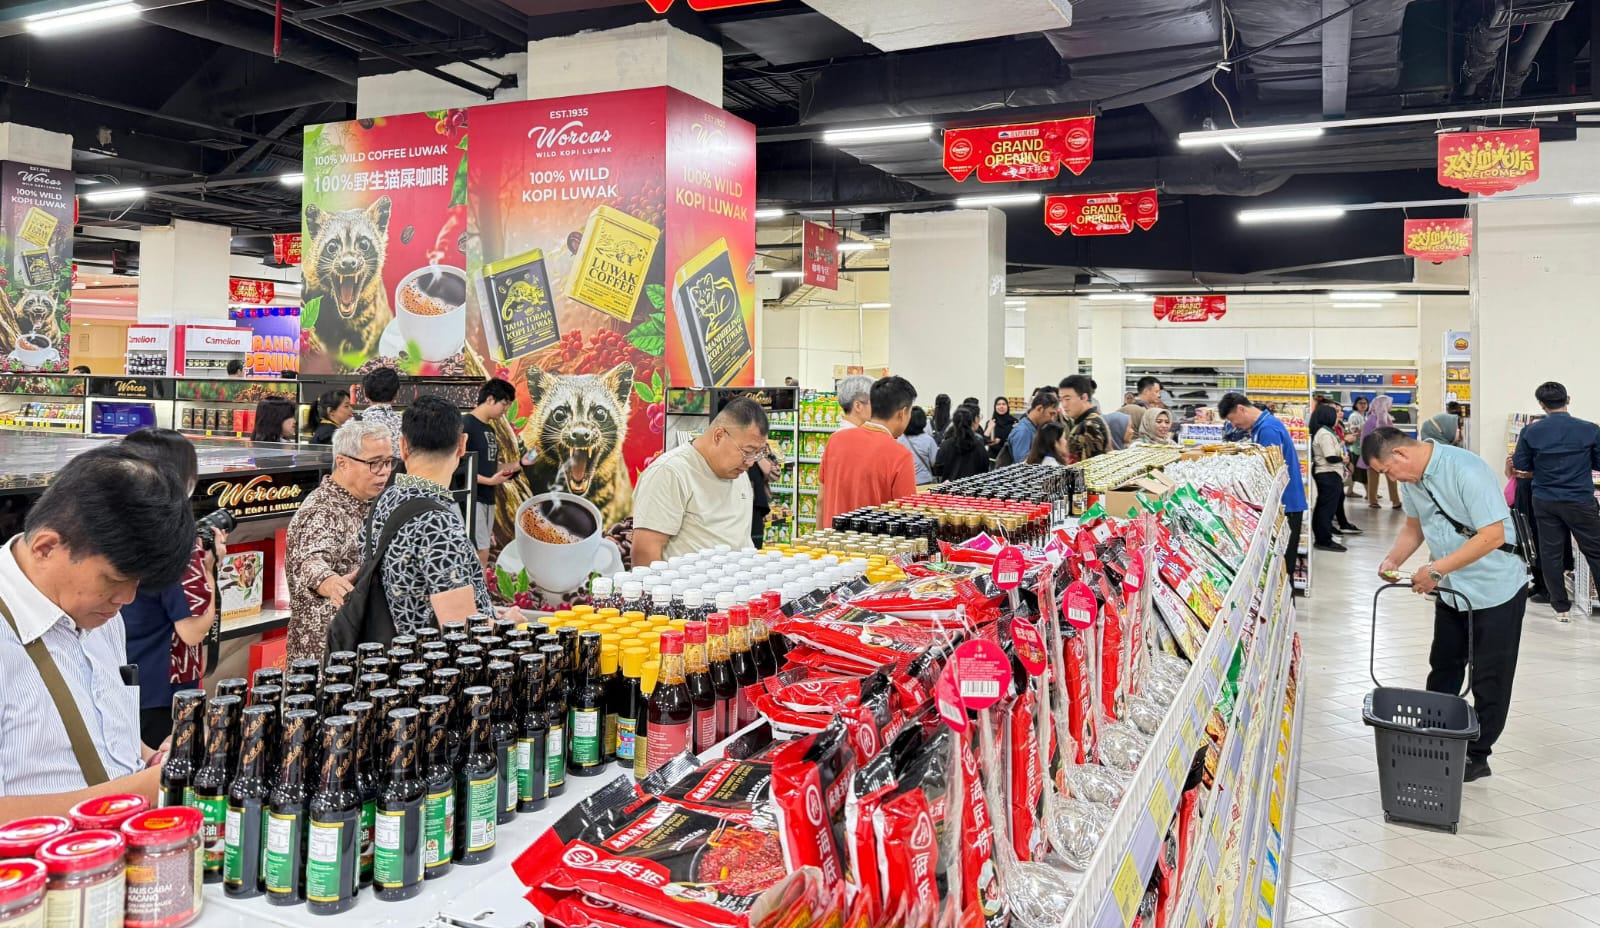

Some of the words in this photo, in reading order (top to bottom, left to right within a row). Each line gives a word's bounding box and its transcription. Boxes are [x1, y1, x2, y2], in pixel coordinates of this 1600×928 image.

[549, 108, 589, 119] EST.1935
[527, 120, 612, 149] Worcas
[582, 147, 612, 155] LUWAK
[991, 139, 1044, 154] GRAND
[314, 155, 338, 167] 100%
[340, 152, 366, 164] WILD
[367, 147, 407, 161] COFFEE
[408, 144, 448, 158] LUWAK
[984, 151, 1051, 167] OPENING
[529, 170, 566, 185] 100%
[569, 167, 610, 182] WILD
[683, 165, 712, 189] 100%
[714, 176, 743, 198] WILD
[1464, 169, 1516, 179] WELCOME
[11, 195, 34, 205] KOPI
[35, 199, 67, 209] LUWAK
[16, 187, 38, 198] 100%
[40, 191, 62, 201] WILD
[522, 188, 557, 203] KOPI
[561, 184, 618, 201] LUWAK
[676, 187, 705, 211] KOPI
[708, 196, 748, 222] LUWAK
[1082, 204, 1122, 215] GRAND
[1076, 213, 1127, 225] OPENING
[592, 257, 639, 285] LUWAK
[588, 269, 636, 296] COFFEE
[205, 336, 241, 346] Camelion
[252, 335, 293, 352] RAND
[207, 474, 302, 508] Worcas
[815, 827, 839, 892] 海底
